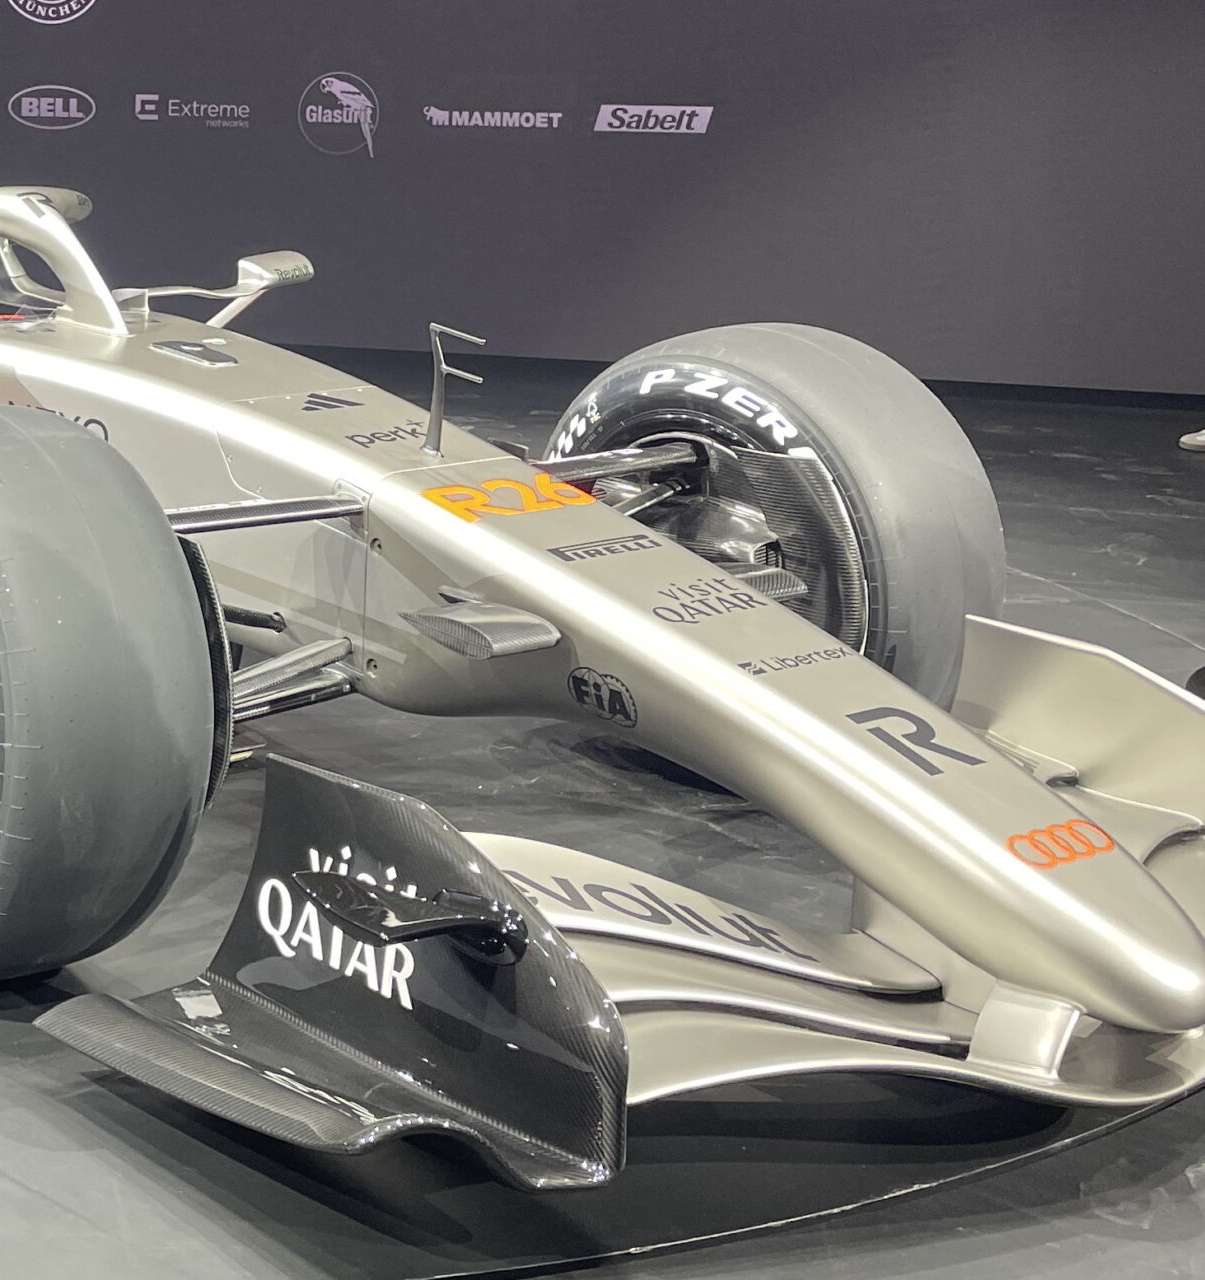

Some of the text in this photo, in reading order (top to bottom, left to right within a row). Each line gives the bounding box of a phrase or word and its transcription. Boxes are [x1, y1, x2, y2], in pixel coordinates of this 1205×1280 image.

[21, 97, 84, 118] BELL
[168, 99, 250, 118] Extreme
[451, 110, 563, 128] MAMMOET
[607, 108, 699, 131] Sabelt
[206, 119, 249, 128] networks
[639, 368, 676, 395] P
[345, 426, 428, 449] perk
[421, 473, 597, 524] R26
[546, 534, 662, 562] PIRELLI
[658, 577, 740, 601] visit
[652, 592, 769, 625] QATAR
[761, 646, 855, 672] Libertex
[499, 870, 820, 962] volut
